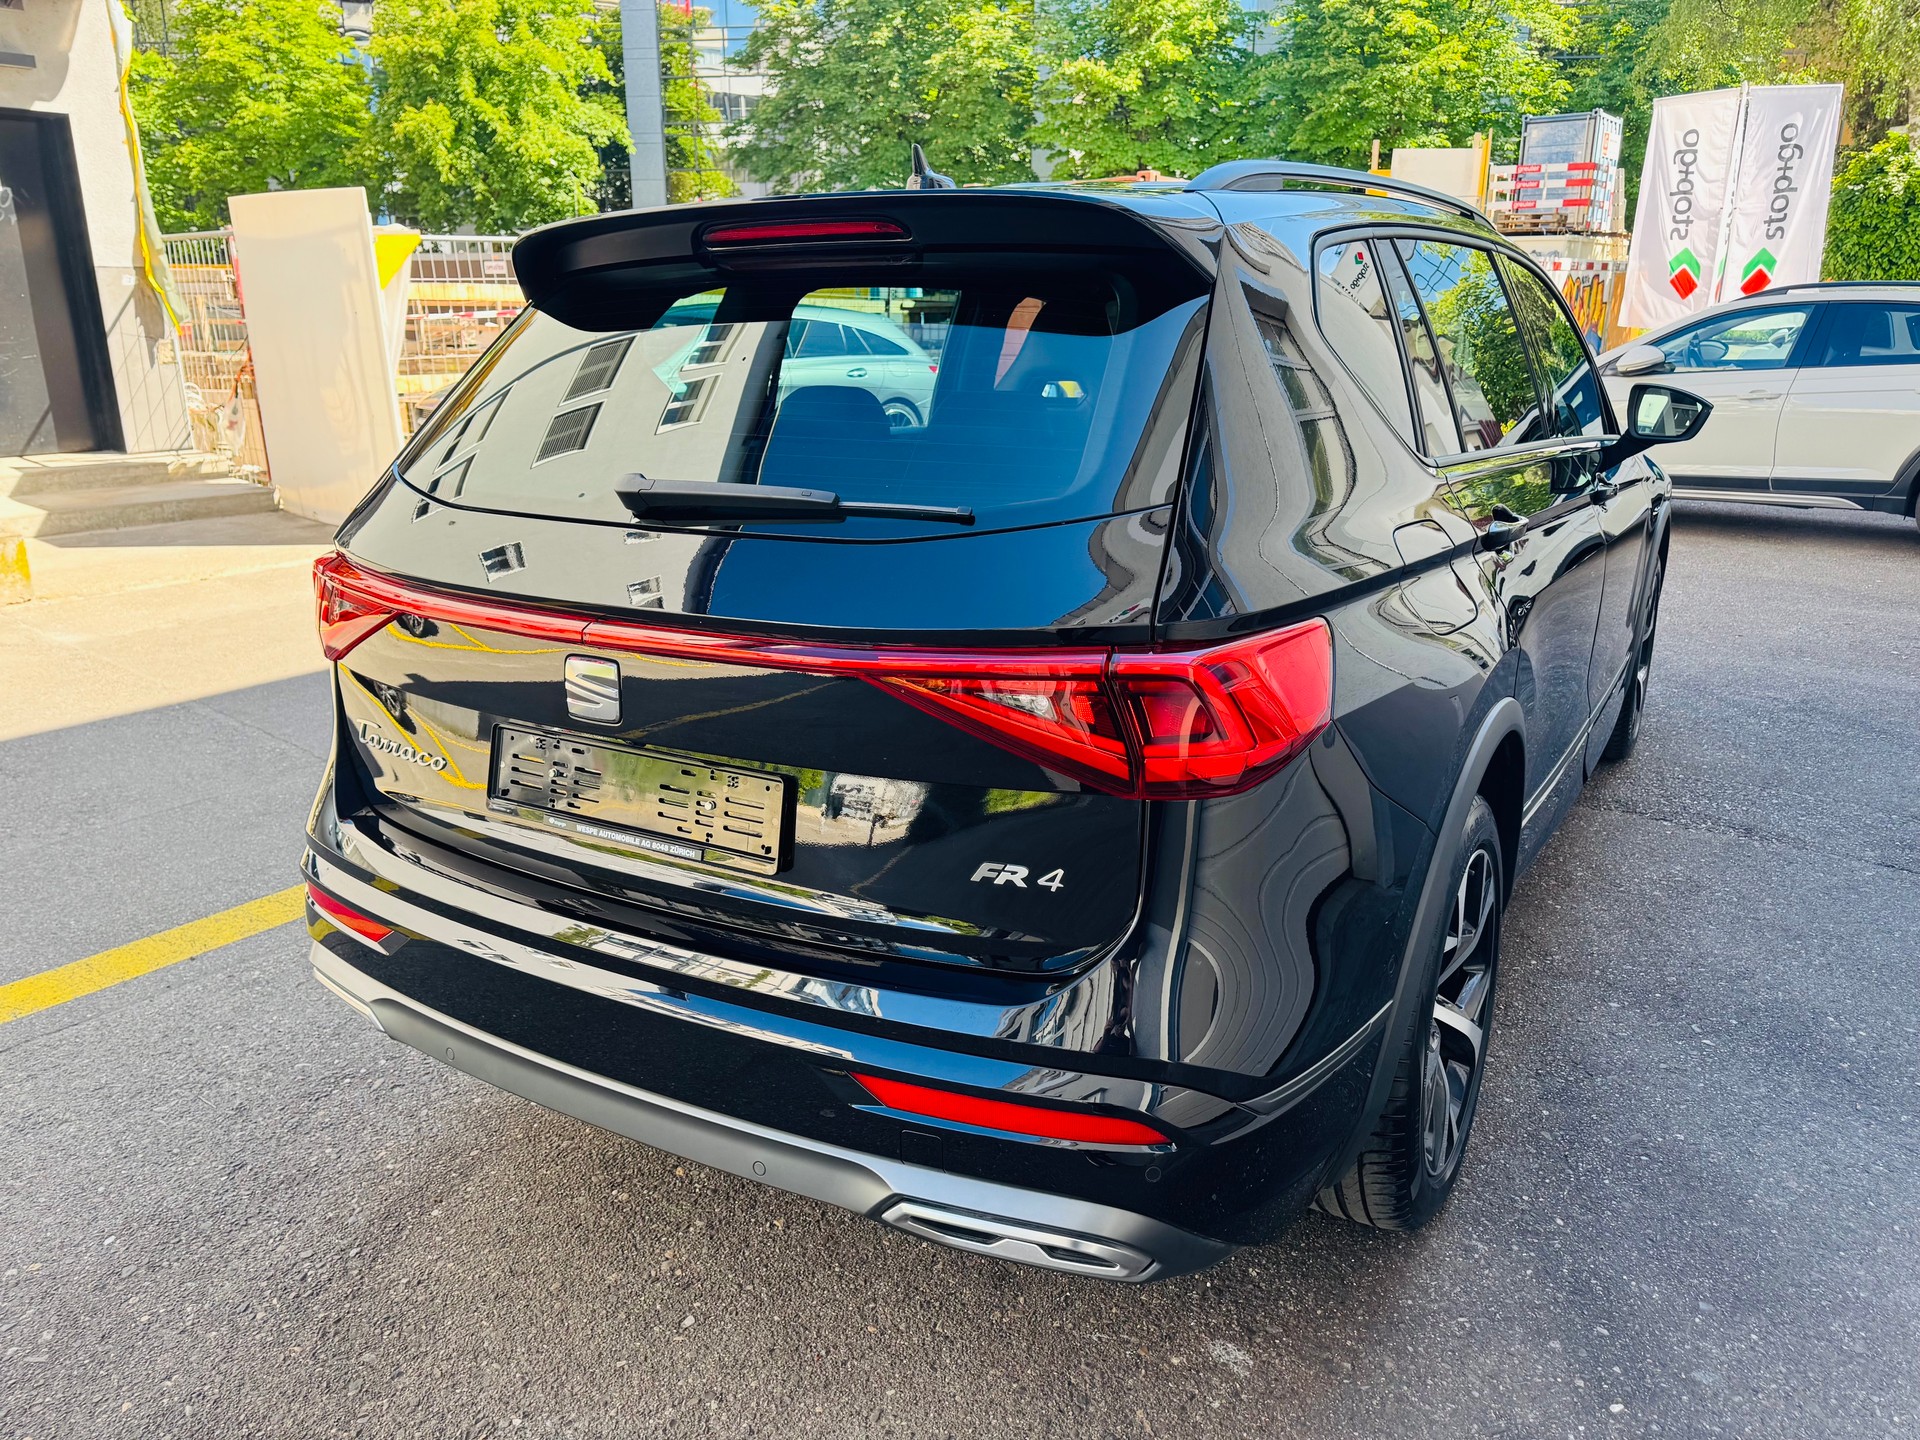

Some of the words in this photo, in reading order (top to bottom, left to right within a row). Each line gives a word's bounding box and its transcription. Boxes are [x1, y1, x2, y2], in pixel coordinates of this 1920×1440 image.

[1763, 122, 1804, 240] stop+go
[356, 718, 447, 771] Tarraco
[576, 823, 598, 836] WESPE
[598, 829, 641, 846] AUTOMOBILE
[641, 839, 651, 848] AG
[652, 841, 669, 852] 8048
[669, 845, 696, 858] ZÜRICH
[970, 860, 1030, 888] FR
[1037, 868, 1065, 892] 4
